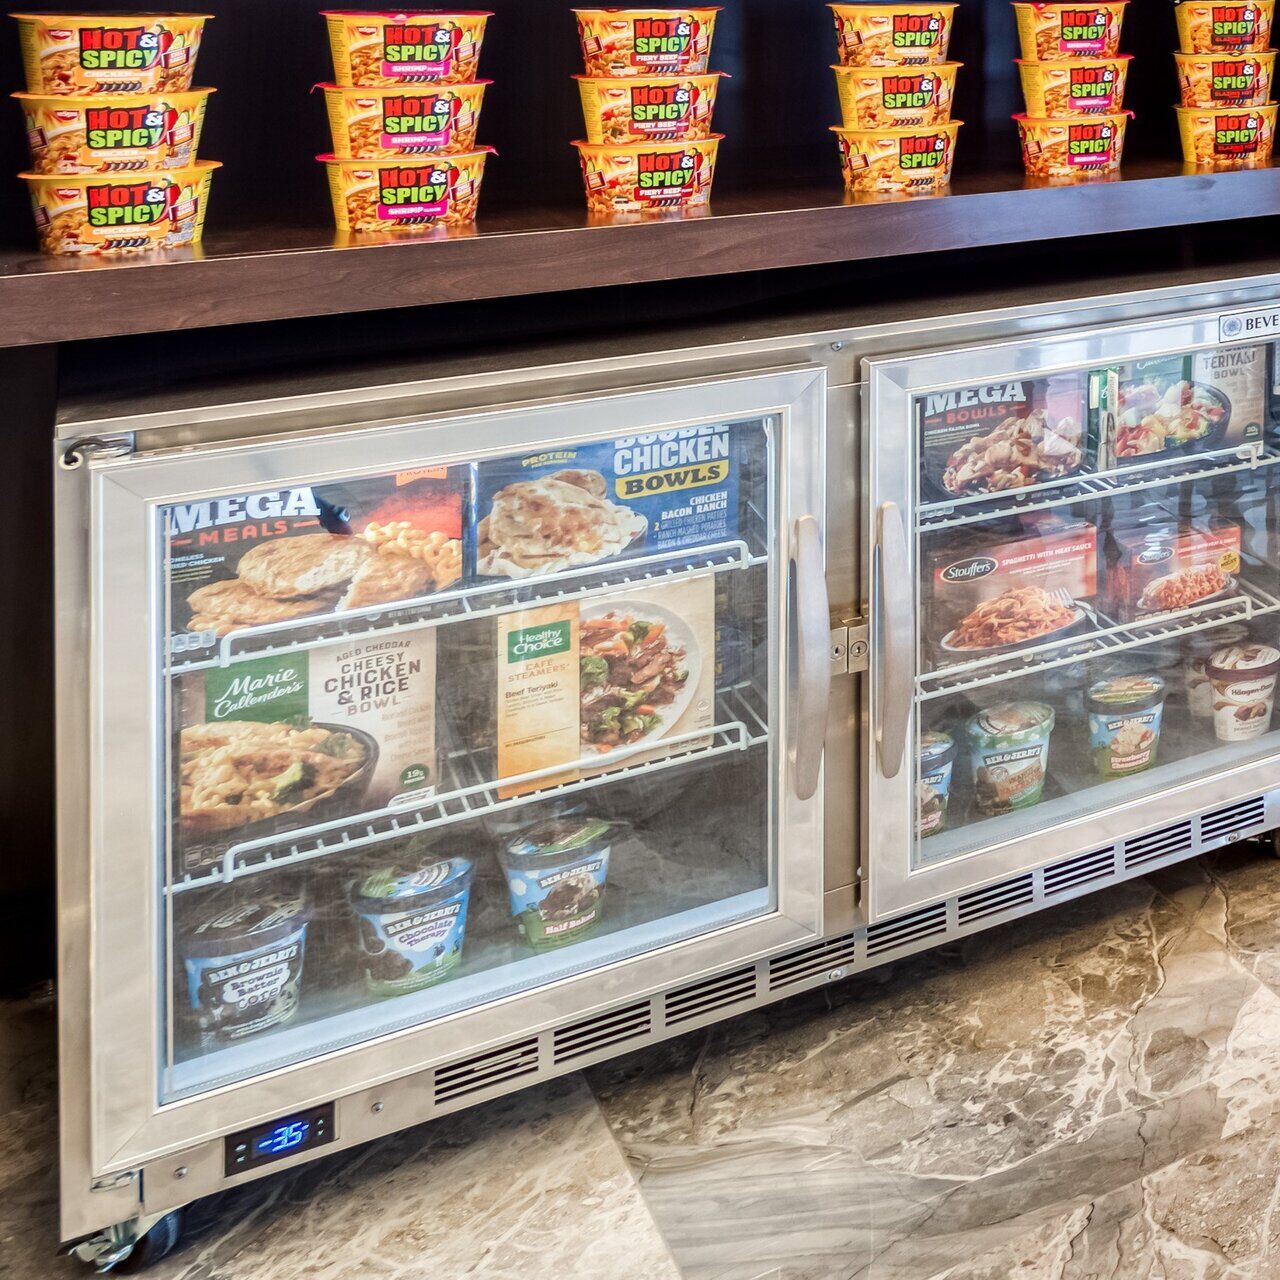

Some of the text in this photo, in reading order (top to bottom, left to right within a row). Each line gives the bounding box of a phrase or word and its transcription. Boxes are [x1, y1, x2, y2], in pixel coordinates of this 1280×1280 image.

[895, 15, 931, 32] HOT
[1063, 12, 1097, 27] HOT
[1212, 7, 1246, 22] HOT
[385, 26, 437, 45] HOT
[635, 20, 680, 38] HOT
[1062, 25, 1106, 41] SPICY
[1212, 21, 1254, 36] SPICY
[81, 28, 142, 50] HOT
[636, 37, 690, 53] SPICY
[894, 31, 940, 47] SPICY
[82, 50, 159, 69] SPICY
[385, 44, 450, 62] SPICY
[1071, 69, 1106, 84] HOT
[1212, 62, 1245, 77] HOT
[883, 77, 923, 94] HOT
[1071, 83, 1113, 98] SPICY
[1212, 76, 1254, 90] SPICY
[633, 87, 679, 105] HOT
[884, 93, 932, 109] SPICY
[384, 97, 436, 116] HOT
[633, 104, 690, 121] SPICY
[88, 109, 149, 131] HOT
[385, 115, 449, 134] SPICY
[1215, 116, 1249, 131] HOT
[89, 129, 162, 148] SPICY
[1069, 126, 1104, 141] HOT
[1216, 130, 1257, 145] SPICY
[901, 137, 936, 154] HOT
[1069, 140, 1111, 155] SPICY
[639, 153, 684, 171] HOT
[900, 153, 944, 169] SPICY
[381, 168, 432, 187] HOT
[640, 170, 694, 187] SPICY
[89, 185, 150, 207] HOT
[382, 186, 447, 205] SPICY
[89, 206, 165, 226] SPICY
[925, 382, 1026, 417] MEGA
[946, 405, 1007, 424] BOWLS
[613, 432, 729, 476] CHICKEN
[625, 465, 721, 496] BOWLS
[690, 491, 728, 506] CHICKEN
[168, 486, 320, 536] MEGA
[662, 500, 727, 520] BACON RANCH
[199, 520, 288, 546] MEALS
[947, 561, 991, 580] Stouffer's
[512, 635, 565, 656] Choice
[519, 628, 561, 644] Healthy
[336, 640, 411, 663] AGED CHEDDAR
[341, 652, 405, 675] CHEESY
[325, 659, 421, 693] CHICKEN
[508, 664, 567, 683] STEAMERS
[215, 668, 298, 705] Marie
[338, 677, 410, 706] & RICE
[505, 680, 559, 699] Beef Teriyaki
[214, 680, 303, 718] Callender's
[347, 696, 401, 717] BOWL
[387, 918, 412, 935] BEN
[399, 920, 453, 943] Chocolate
[406, 929, 448, 948] Therapy
[208, 966, 238, 983] BEN
[230, 967, 284, 991] Brownie
[237, 977, 281, 997] Batter
